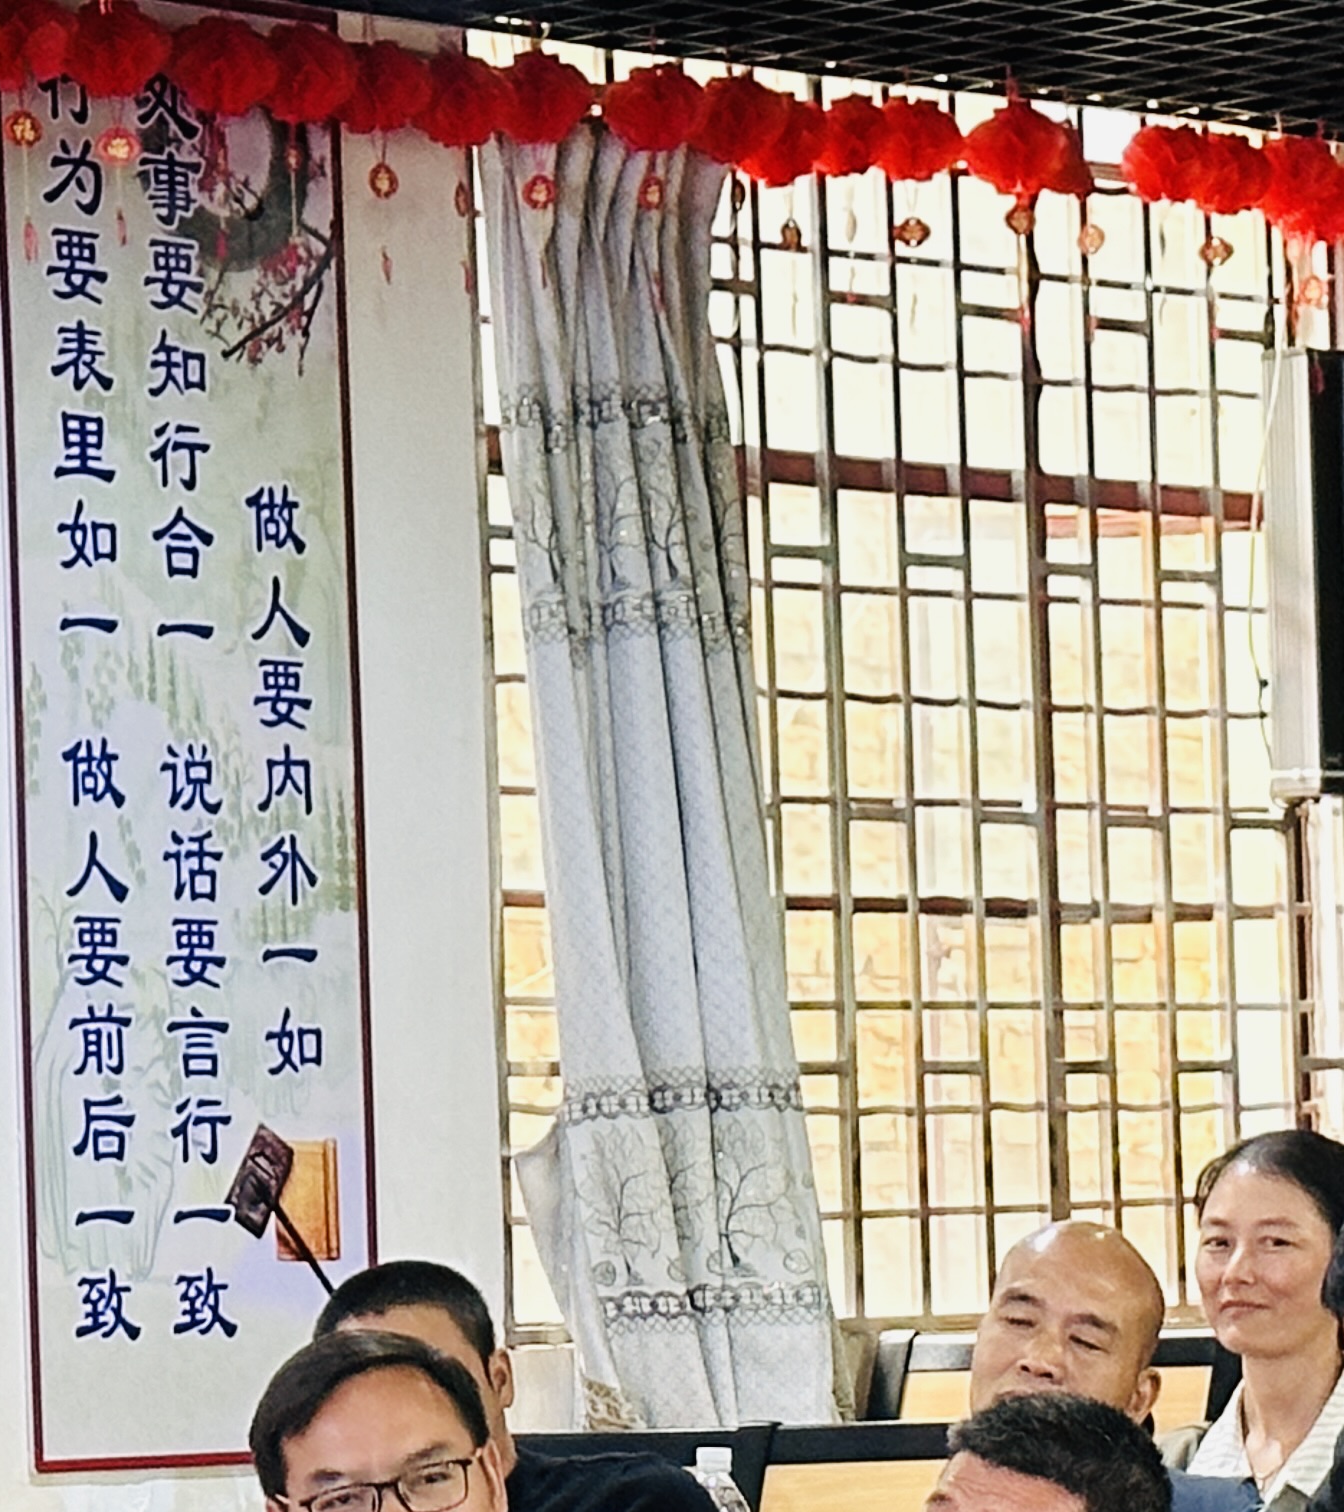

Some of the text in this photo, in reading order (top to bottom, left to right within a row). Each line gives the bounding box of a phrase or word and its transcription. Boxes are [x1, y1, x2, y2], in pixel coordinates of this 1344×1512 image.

[61, 737, 142, 1342] 做人要前后一致
[159, 742, 238, 1341] 说话要言行一致
[245, 484, 323, 1077] 做人要内外一如
